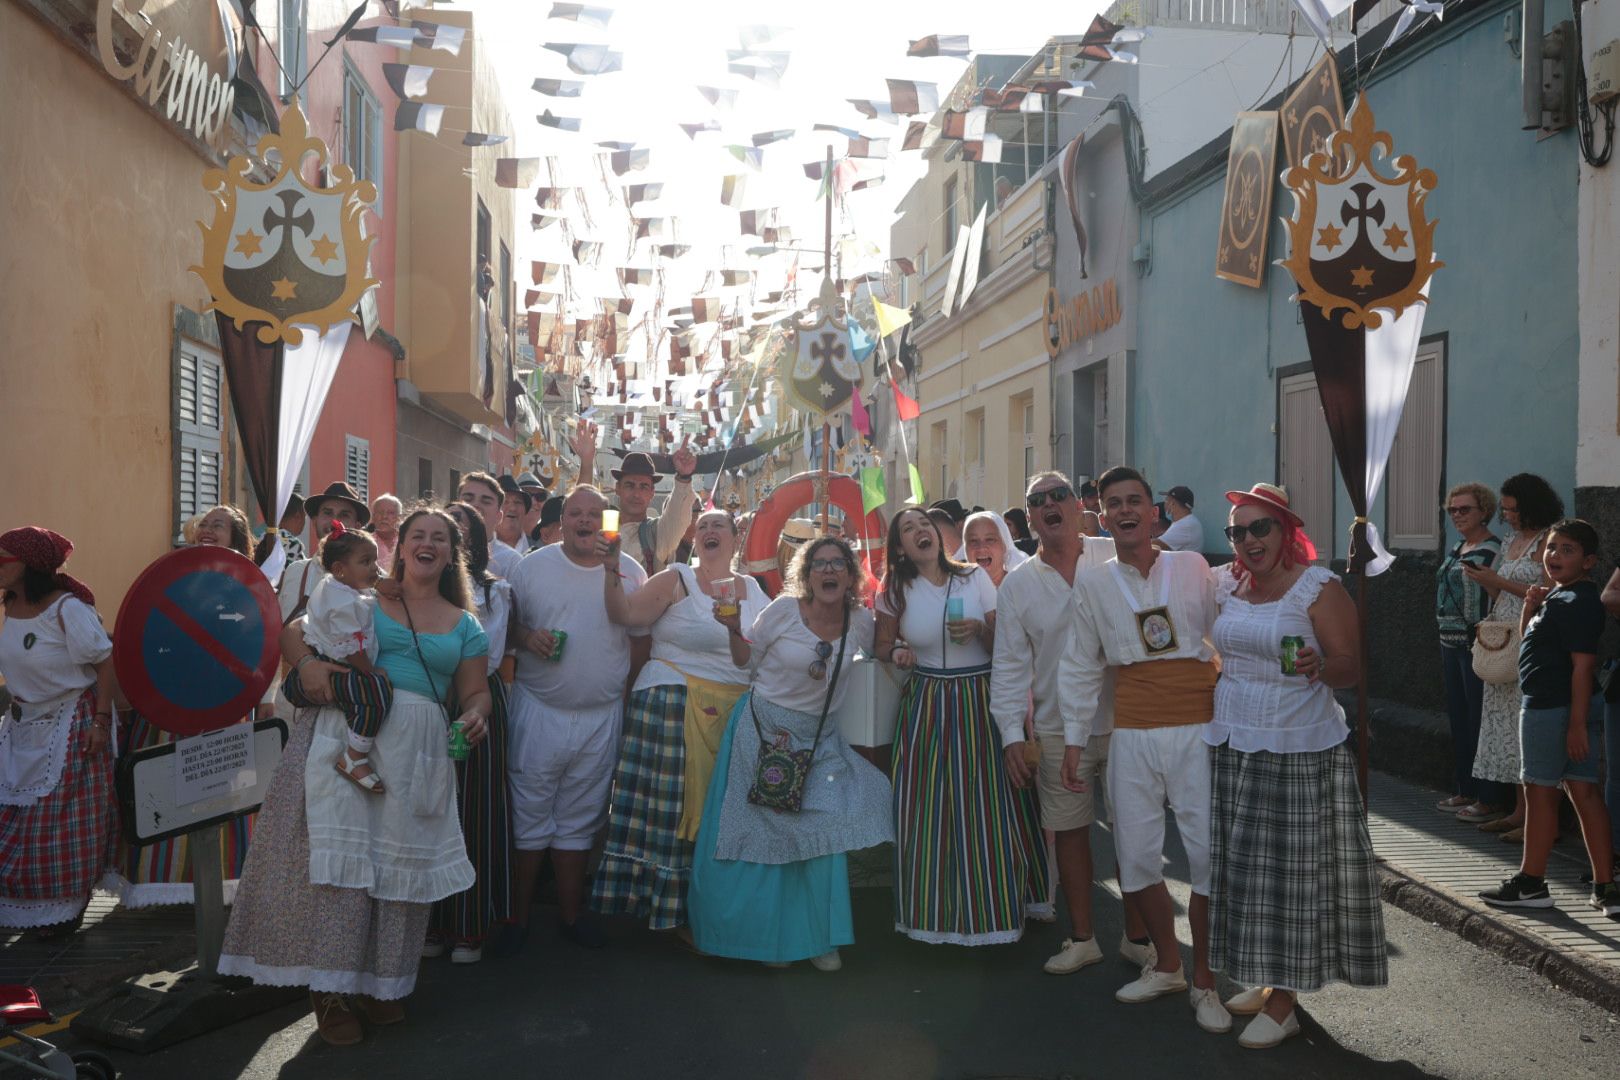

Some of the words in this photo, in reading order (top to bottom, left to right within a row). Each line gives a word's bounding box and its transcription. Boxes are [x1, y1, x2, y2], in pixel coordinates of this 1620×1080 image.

[97, 0, 235, 154] Carmen
[1043, 278, 1121, 358] Carmen
[181, 744, 203, 757] DESDE
[224, 732, 249, 745] HORAS
[182, 761, 205, 775] HASTA
[224, 749, 249, 762] HORAS
[185, 754, 199, 765] DEL
[185, 771, 200, 783] DEL
